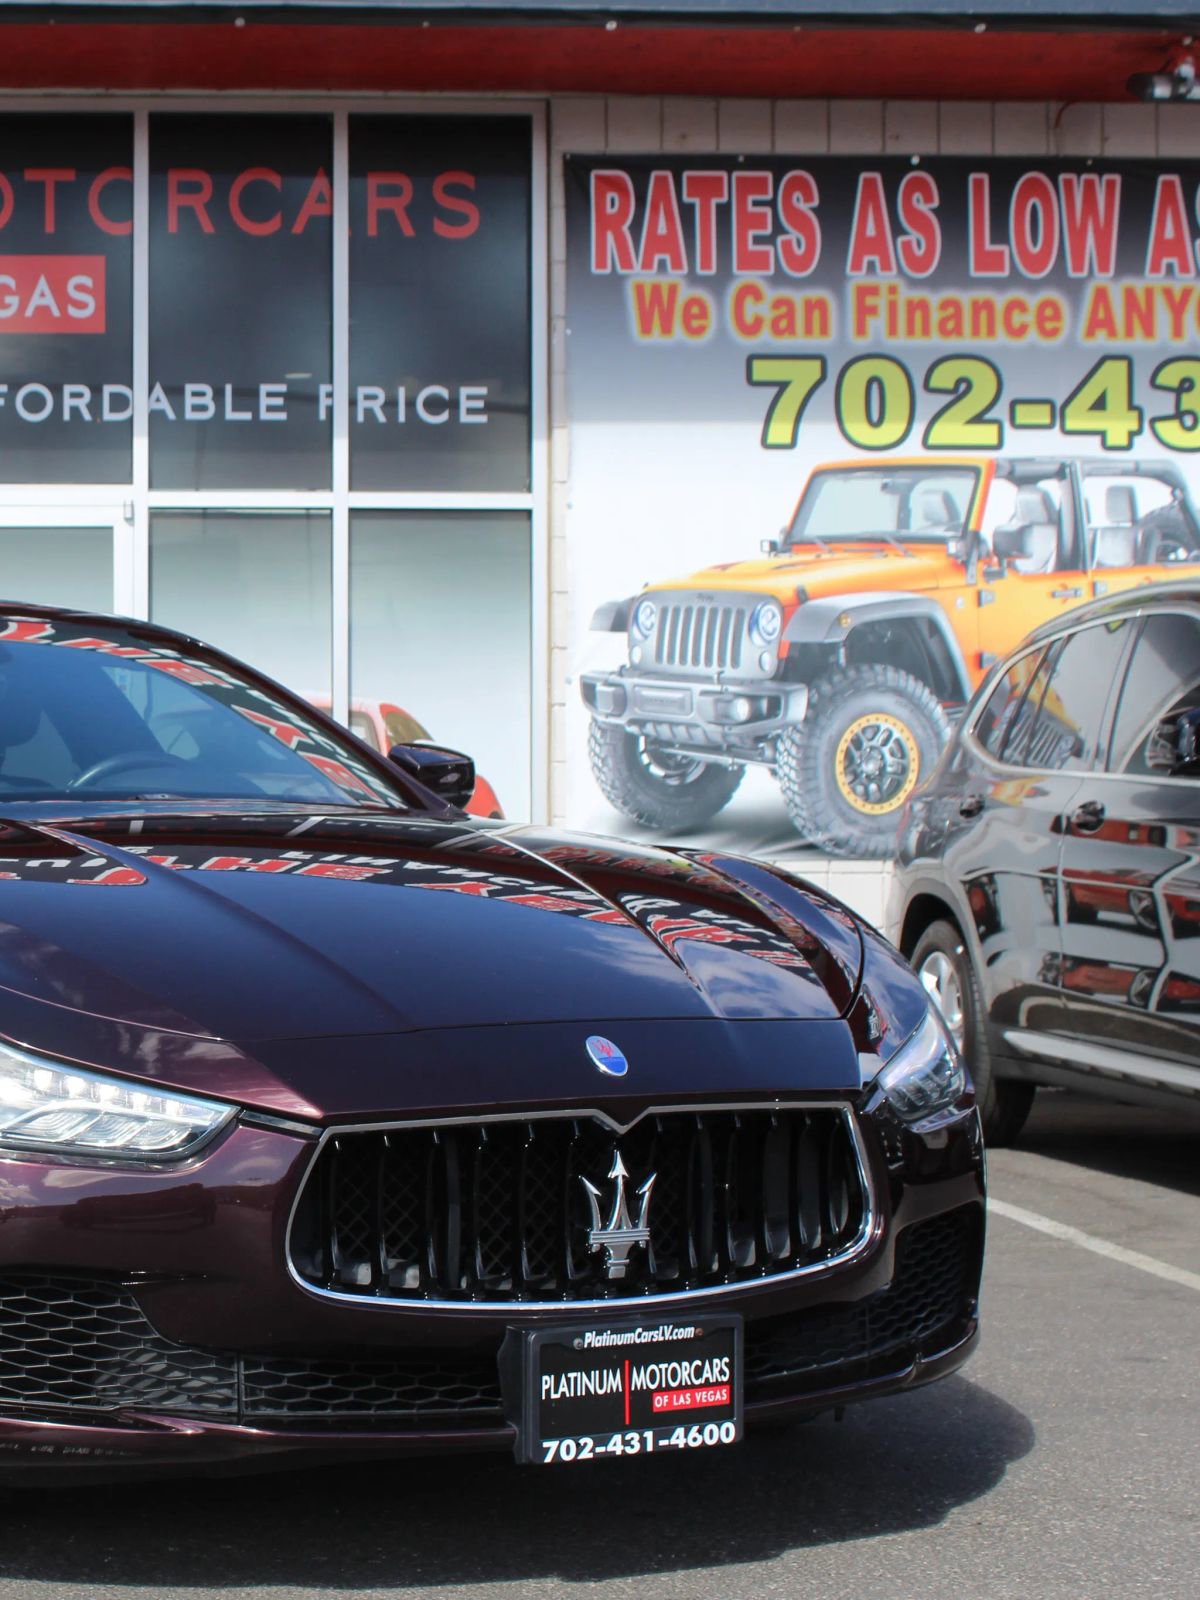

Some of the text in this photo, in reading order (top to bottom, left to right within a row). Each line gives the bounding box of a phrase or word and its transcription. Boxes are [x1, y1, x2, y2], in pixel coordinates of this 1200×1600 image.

[590, 170, 1200, 278] RATES AS LOW A
[632, 281, 1200, 341] We Can Finance ANY
[583, 1325, 696, 1349] PlatinumCarsLV.com
[541, 1356, 731, 1400] PLATINUM MOTORCARS
[654, 1388, 728, 1408] OF LAS VEGAS
[542, 1421, 737, 1463] 702-431-4600
